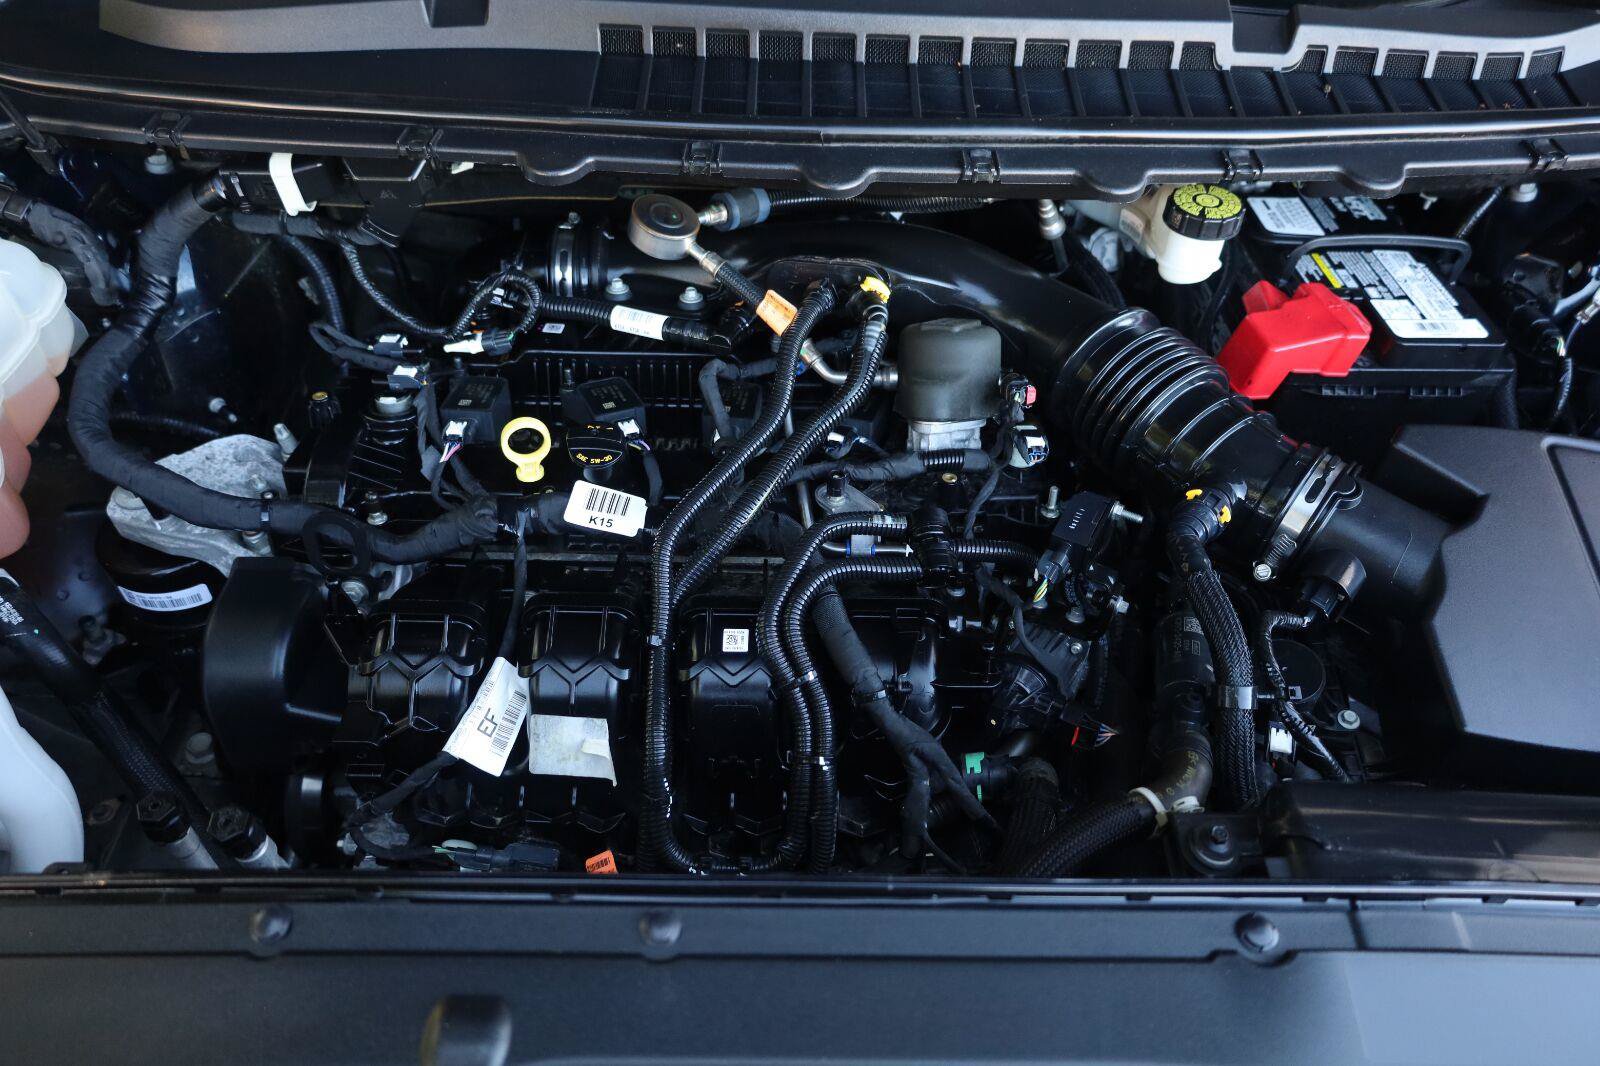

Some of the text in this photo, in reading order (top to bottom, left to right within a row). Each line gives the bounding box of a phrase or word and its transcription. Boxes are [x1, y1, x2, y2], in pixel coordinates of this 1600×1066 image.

[576, 453, 588, 463] SAE
[588, 516, 613, 528] K15
[477, 707, 498, 738] EF
